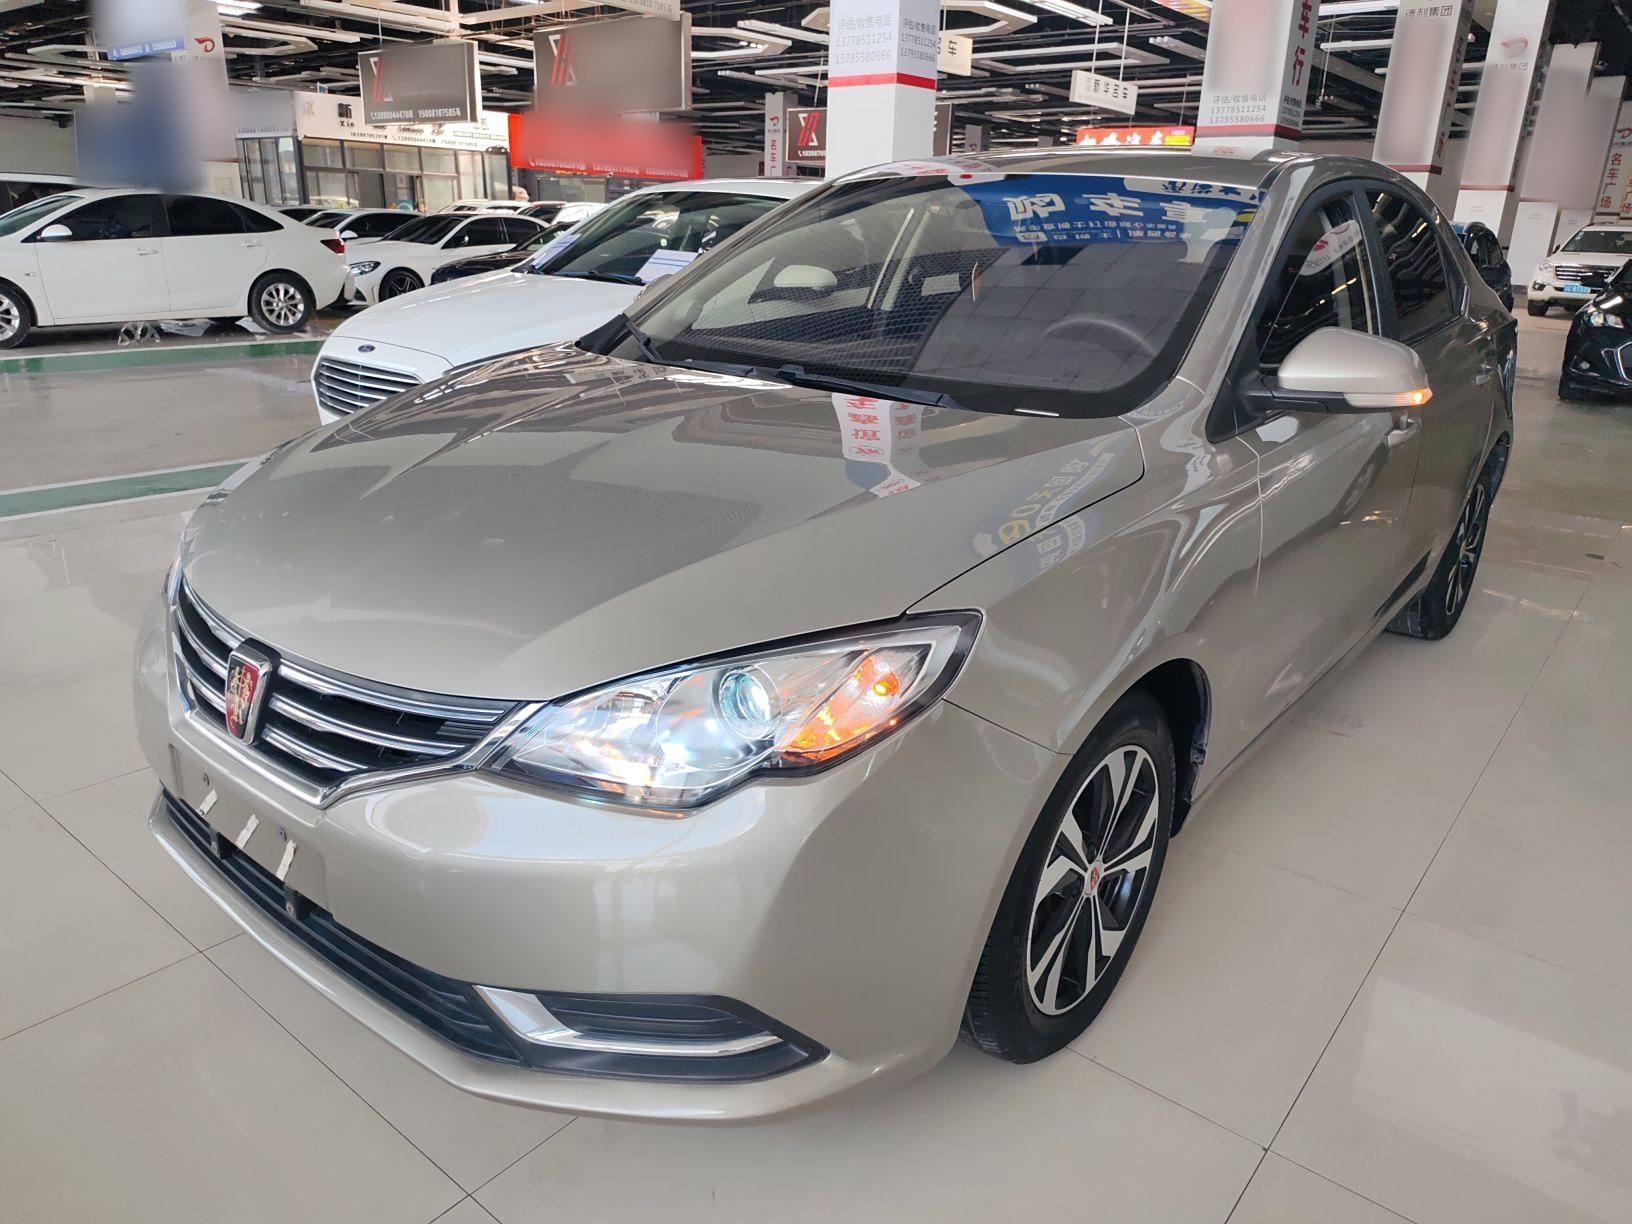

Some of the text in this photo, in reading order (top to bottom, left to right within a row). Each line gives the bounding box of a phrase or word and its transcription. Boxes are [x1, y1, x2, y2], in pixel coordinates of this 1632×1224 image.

[1405, 5, 1453, 19] 德利集团
[835, 32, 892, 47] 13778511254
[835, 50, 892, 64] 13795580666
[1211, 104, 1266, 114] 13778511254
[1600, 152, 1623, 209] 名车广场
